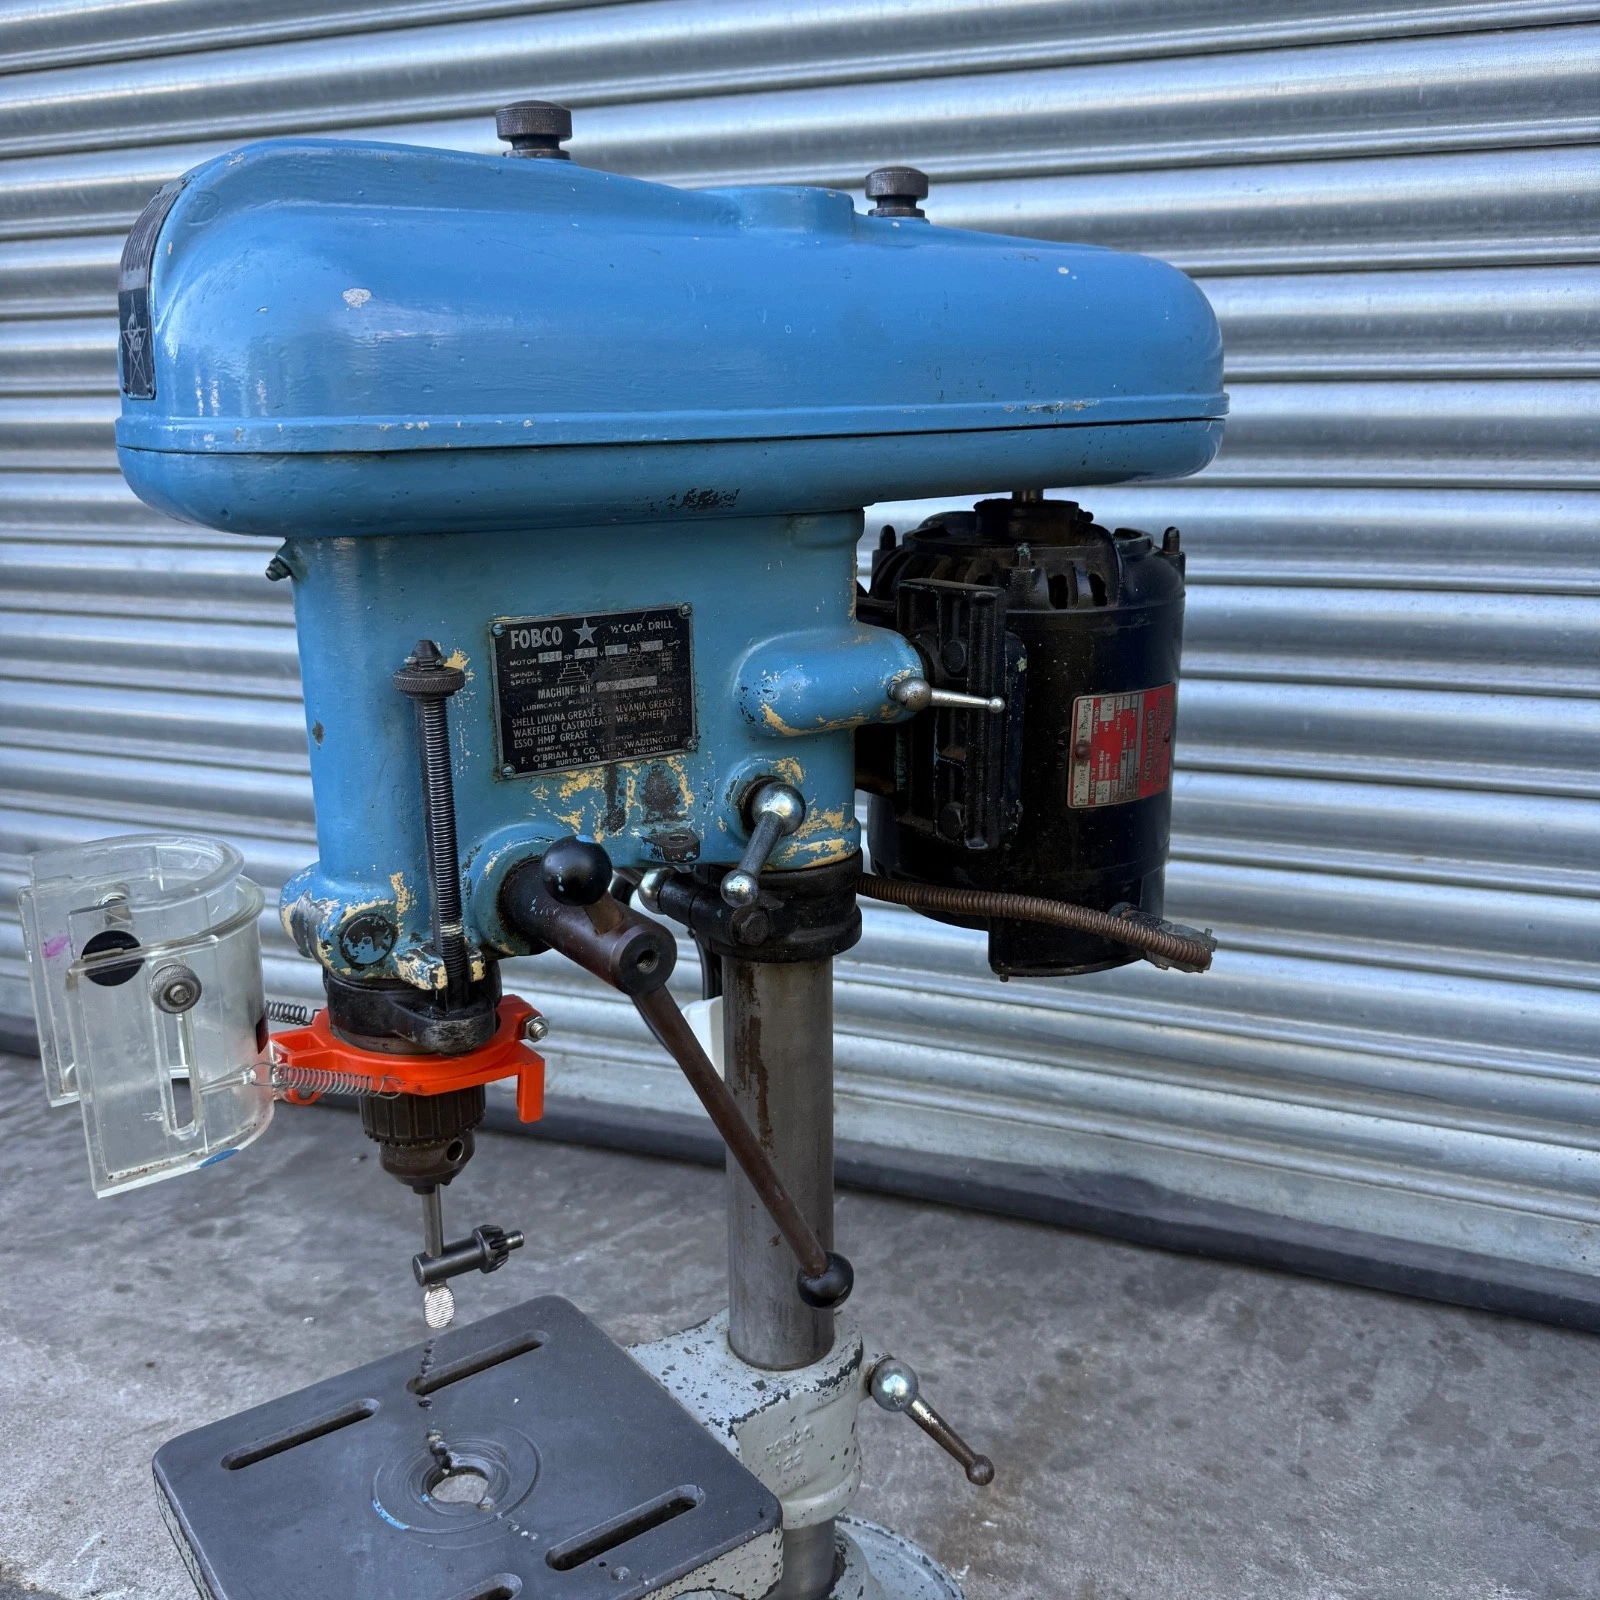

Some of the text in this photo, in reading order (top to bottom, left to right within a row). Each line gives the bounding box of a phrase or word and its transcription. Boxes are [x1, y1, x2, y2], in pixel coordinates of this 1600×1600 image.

[648, 620, 673, 630] DRILL
[510, 626, 562, 650] FOBCO
[510, 670, 542, 678] SPINDLE
[538, 686, 575, 699] MACHINE
[522, 702, 562, 712] LUBRICATE
[616, 702, 646, 713] ALVANIA
[649, 699, 676, 709] GREASE
[512, 716, 535, 728] SHELL
[538, 713, 565, 724] LIVONA
[568, 707, 596, 720] GREASE
[513, 724, 557, 738] WAKEFIELD
[639, 709, 674, 720] SPHEEROL
[514, 730, 588, 749] ESSO HMP GREASE
[1143, 708, 1155, 781] GRYPHON
[533, 751, 568, 762] O'BRIAN
[556, 757, 582, 766] BURTON
